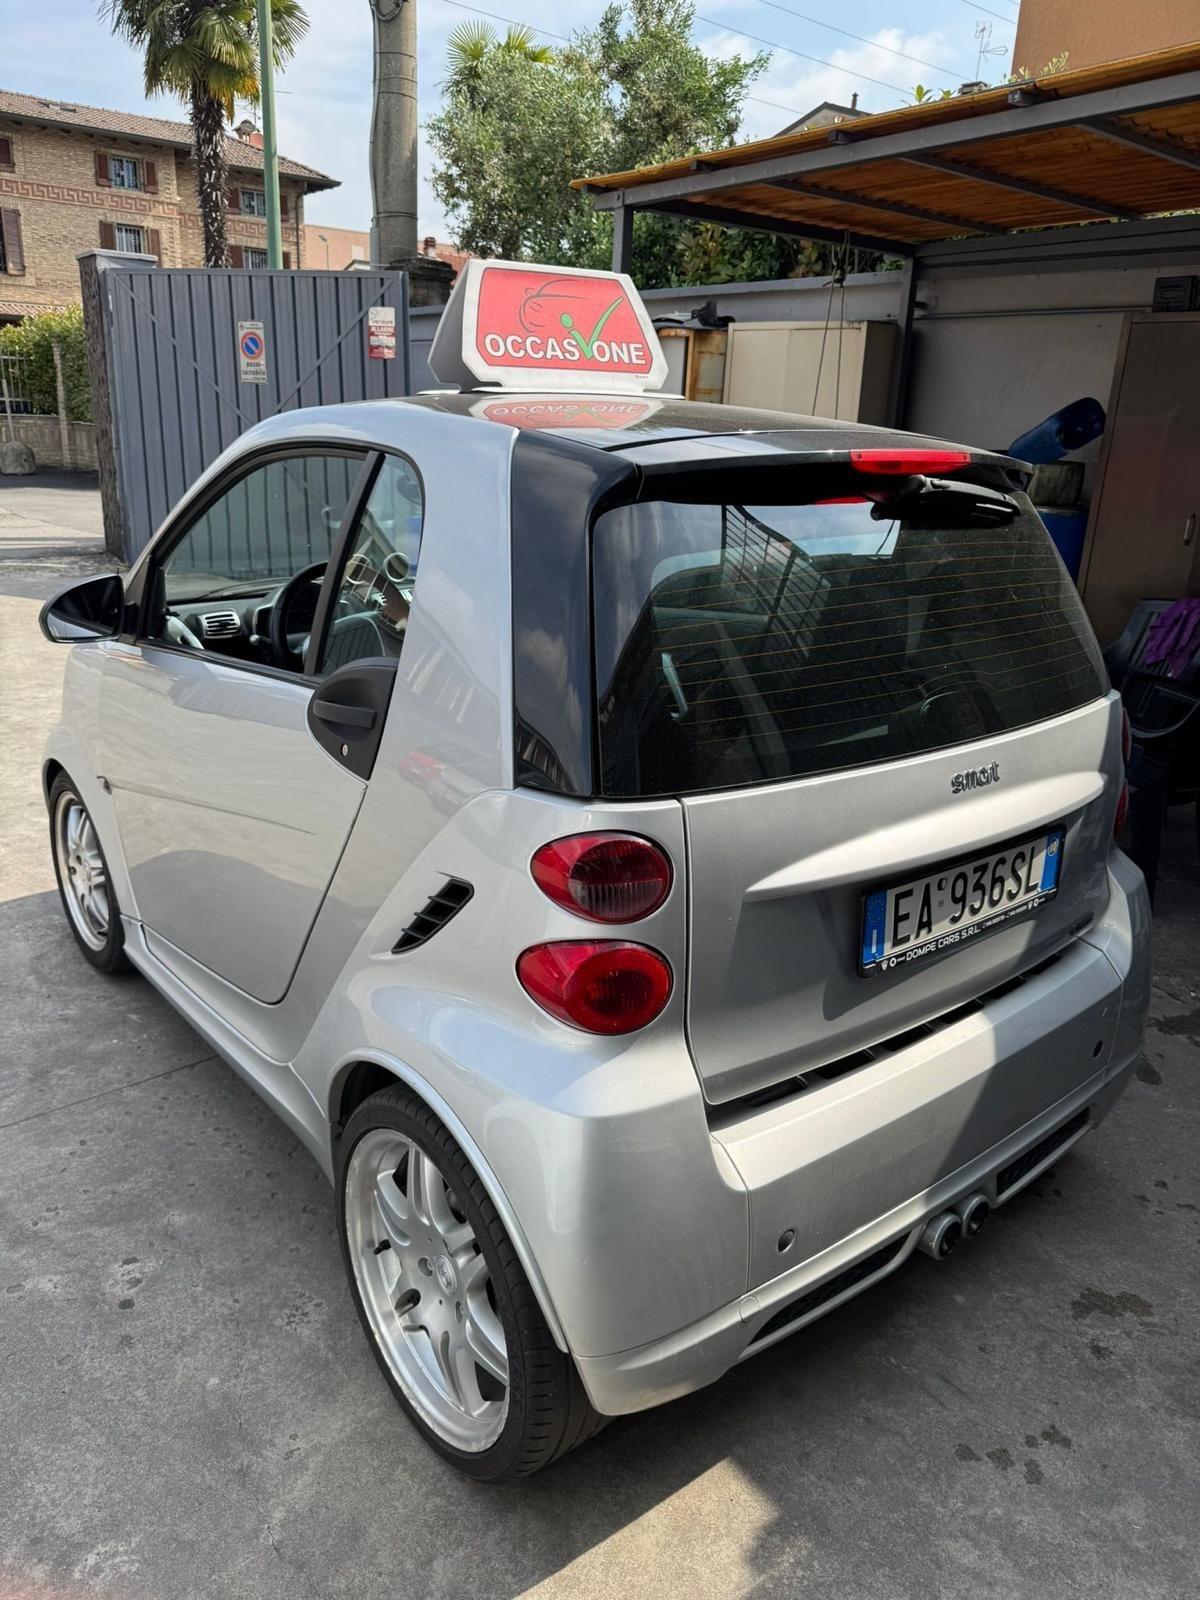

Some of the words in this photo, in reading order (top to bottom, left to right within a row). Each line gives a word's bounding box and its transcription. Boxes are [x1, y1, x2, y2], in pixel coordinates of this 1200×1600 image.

[951, 761, 1000, 794] smart
[906, 941, 938, 961] DOMPE
[938, 932, 960, 949] CARS
